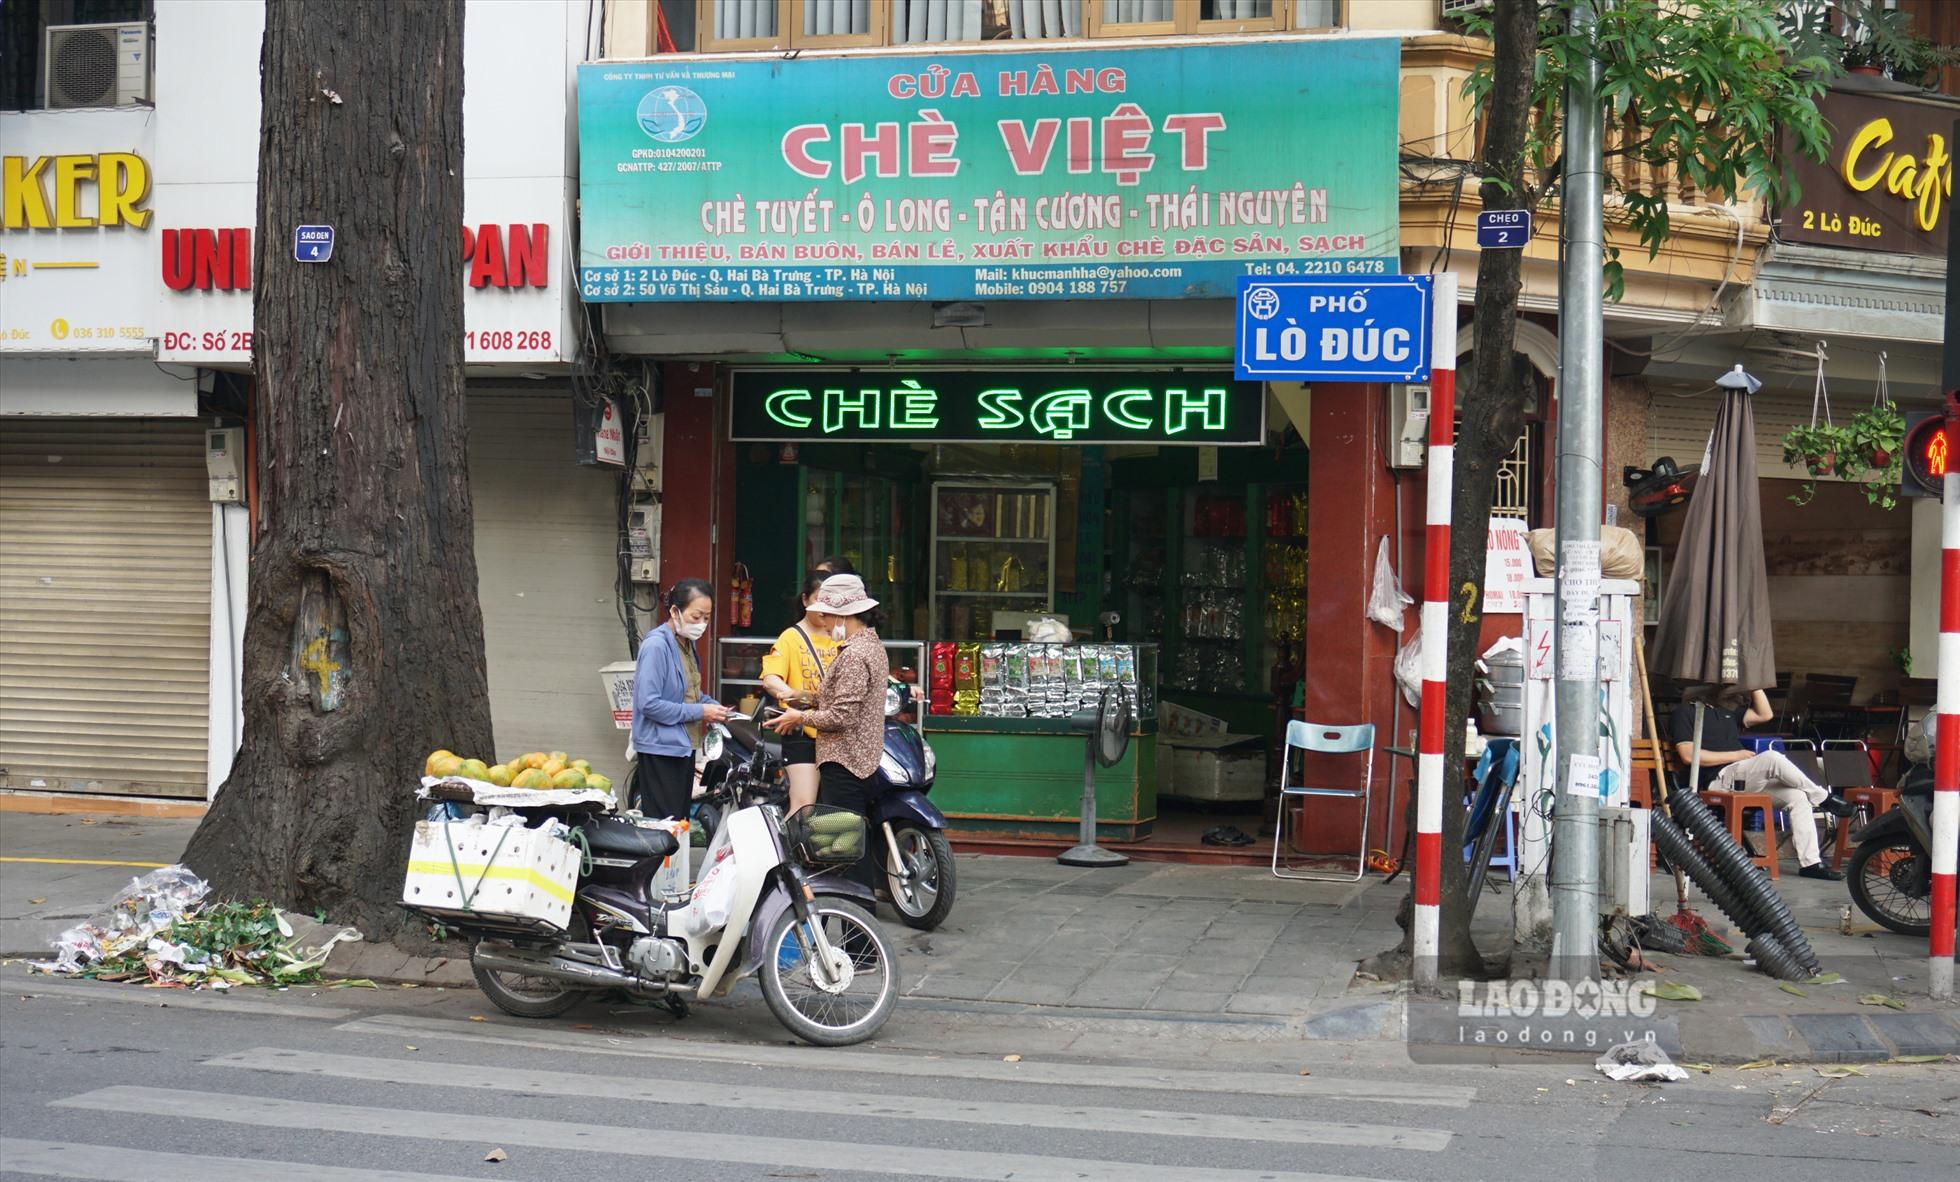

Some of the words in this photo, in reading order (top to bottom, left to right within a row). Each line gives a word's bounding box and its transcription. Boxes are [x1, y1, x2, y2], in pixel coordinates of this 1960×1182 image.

[888, 64, 981, 98] CỬA
[998, 63, 1127, 96] HÀNG
[781, 108, 960, 185] CHÈ
[997, 103, 1227, 186] VIỆT
[1842, 117, 1952, 231] Caf
[0, 152, 154, 230] KER
[701, 193, 747, 238] CHÈ
[755, 188, 834, 237] TUYẾT
[857, 191, 875, 233] Ô
[885, 199, 951, 233] LONG
[974, 190, 1027, 236] TÂN
[1035, 190, 1121, 230] CƯƠNG
[1145, 184, 1210, 232] THÁI
[1218, 181, 1328, 229] NGUYÊN
[1489, 213, 1519, 226] CHẸO
[301, 231, 316, 240] SAO
[1803, 210, 1814, 230] 2
[1820, 212, 1842, 232] Lò
[1848, 215, 1882, 237] Đúc
[606, 241, 651, 261] GIỚI
[658, 241, 732, 263] THIỆU,
[739, 242, 786, 260] BÁN
[794, 241, 864, 262] BUÔN,
[872, 240, 920, 260] BÁN
[927, 238, 966, 262] LẺ,
[972, 238, 1034, 260] XUẤT
[1042, 234, 1109, 258] KHẨU
[1116, 236, 1166, 256] CHÈ
[1174, 236, 1226, 258] ĐẶC
[1233, 232, 1291, 255] SẢN,
[1298, 235, 1366, 255] SẠCH
[1498, 231, 1509, 243] 2
[162, 228, 251, 291] UNI
[310, 246, 319, 257] 4
[584, 270, 601, 282] Cơ
[604, 269, 620, 281] sở
[624, 270, 636, 281] 1:
[640, 270, 648, 281] 2
[652, 269, 668, 281] Lò
[672, 269, 698, 281] Đúc
[709, 270, 723, 282] Q.
[728, 270, 748, 281] Hai
[752, 269, 769, 281] Bà
[773, 269, 812, 282] Trưng
[824, 269, 847, 281] TP.
[851, 269, 868, 281] Hà
[873, 269, 895, 282] Nội
[975, 268, 1007, 281] Mail:
[1012, 266, 1182, 281] khucmanhha@yahoo.com
[1245, 263, 1272, 275] Tel:
[1276, 263, 1300, 275] 04.
[1304, 261, 1342, 274] 2210
[1346, 260, 1385, 274] 6478
[584, 284, 601, 296] Cơ
[603, 283, 620, 296] sở
[623, 284, 636, 296] 2:
[640, 284, 656, 296] 50
[660, 283, 677, 295] Võ
[680, 284, 700, 298] Thị
[704, 283, 728, 296] Sáu
[740, 284, 754, 297] Q.
[758, 284, 779, 296] Hai
[783, 283, 801, 296] Bà
[805, 284, 844, 297] Trưng
[857, 284, 879, 296] TP.
[883, 283, 901, 295] Hà
[905, 283, 928, 298] Nội
[975, 283, 1024, 295] Mobile:
[1028, 282, 1064, 294] 0904
[1070, 281, 1096, 293] 188
[1101, 281, 1127, 293] 757
[1310, 288, 1371, 313] PHỐ
[73, 328, 93, 338] 036
[97, 328, 115, 338] 310
[119, 327, 145, 338] 5555
[164, 332, 197, 350] ĐC:
[202, 329, 227, 351] Số
[465, 331, 475, 350] 1
[480, 331, 513, 350] 608
[517, 331, 551, 350] 268
[1255, 318, 1307, 361] LÒ
[1320, 318, 1411, 362] ĐÚC
[765, 379, 940, 434] CHÈ
[977, 388, 1227, 439] SẠCH
[1496, 525, 1520, 551] NÓNG
[301, 637, 340, 694] 4
